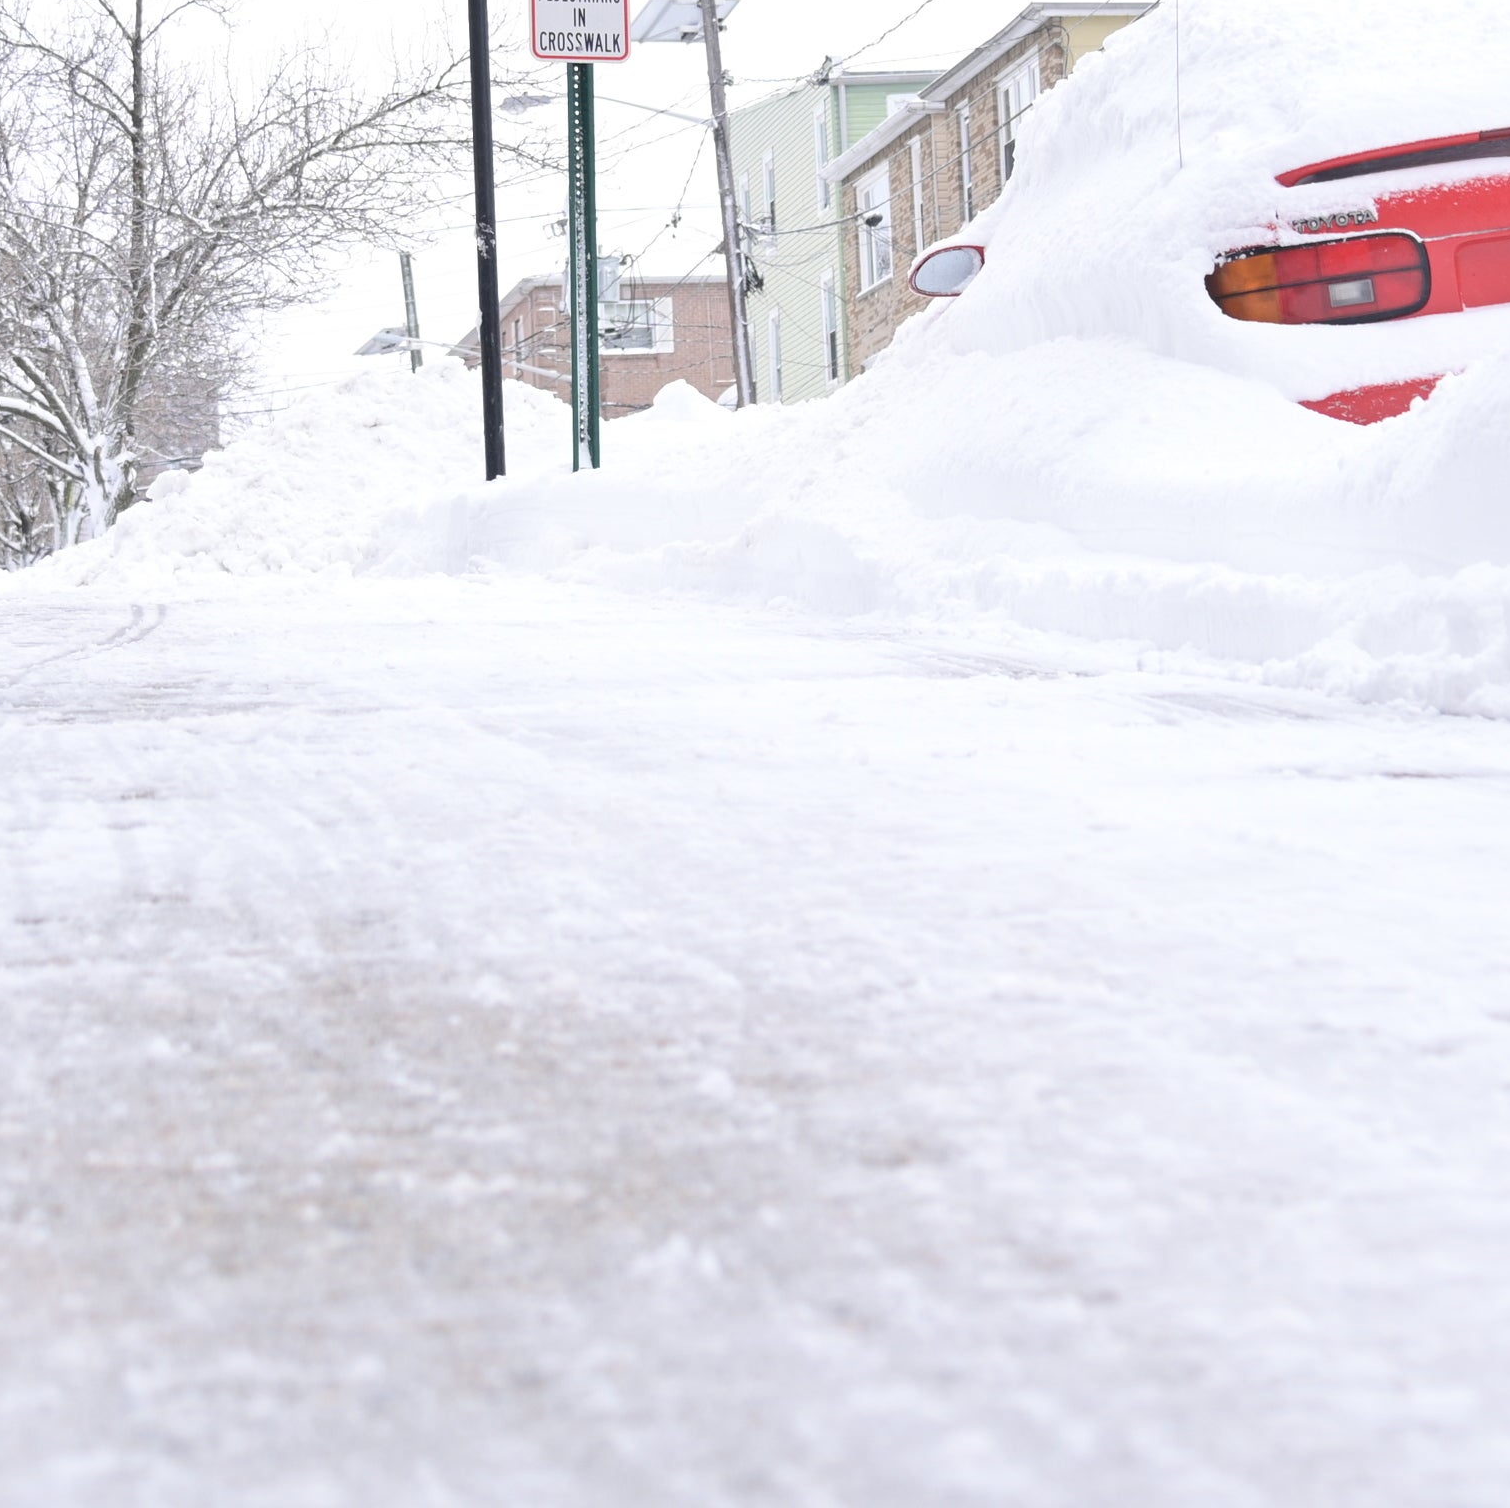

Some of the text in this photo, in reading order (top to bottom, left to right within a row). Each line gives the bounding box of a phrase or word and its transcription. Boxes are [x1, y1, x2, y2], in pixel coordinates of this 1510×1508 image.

[573, 8, 586, 27] IN
[539, 31, 621, 53] CROSSWALK
[1292, 209, 1379, 234] TOYOTA
